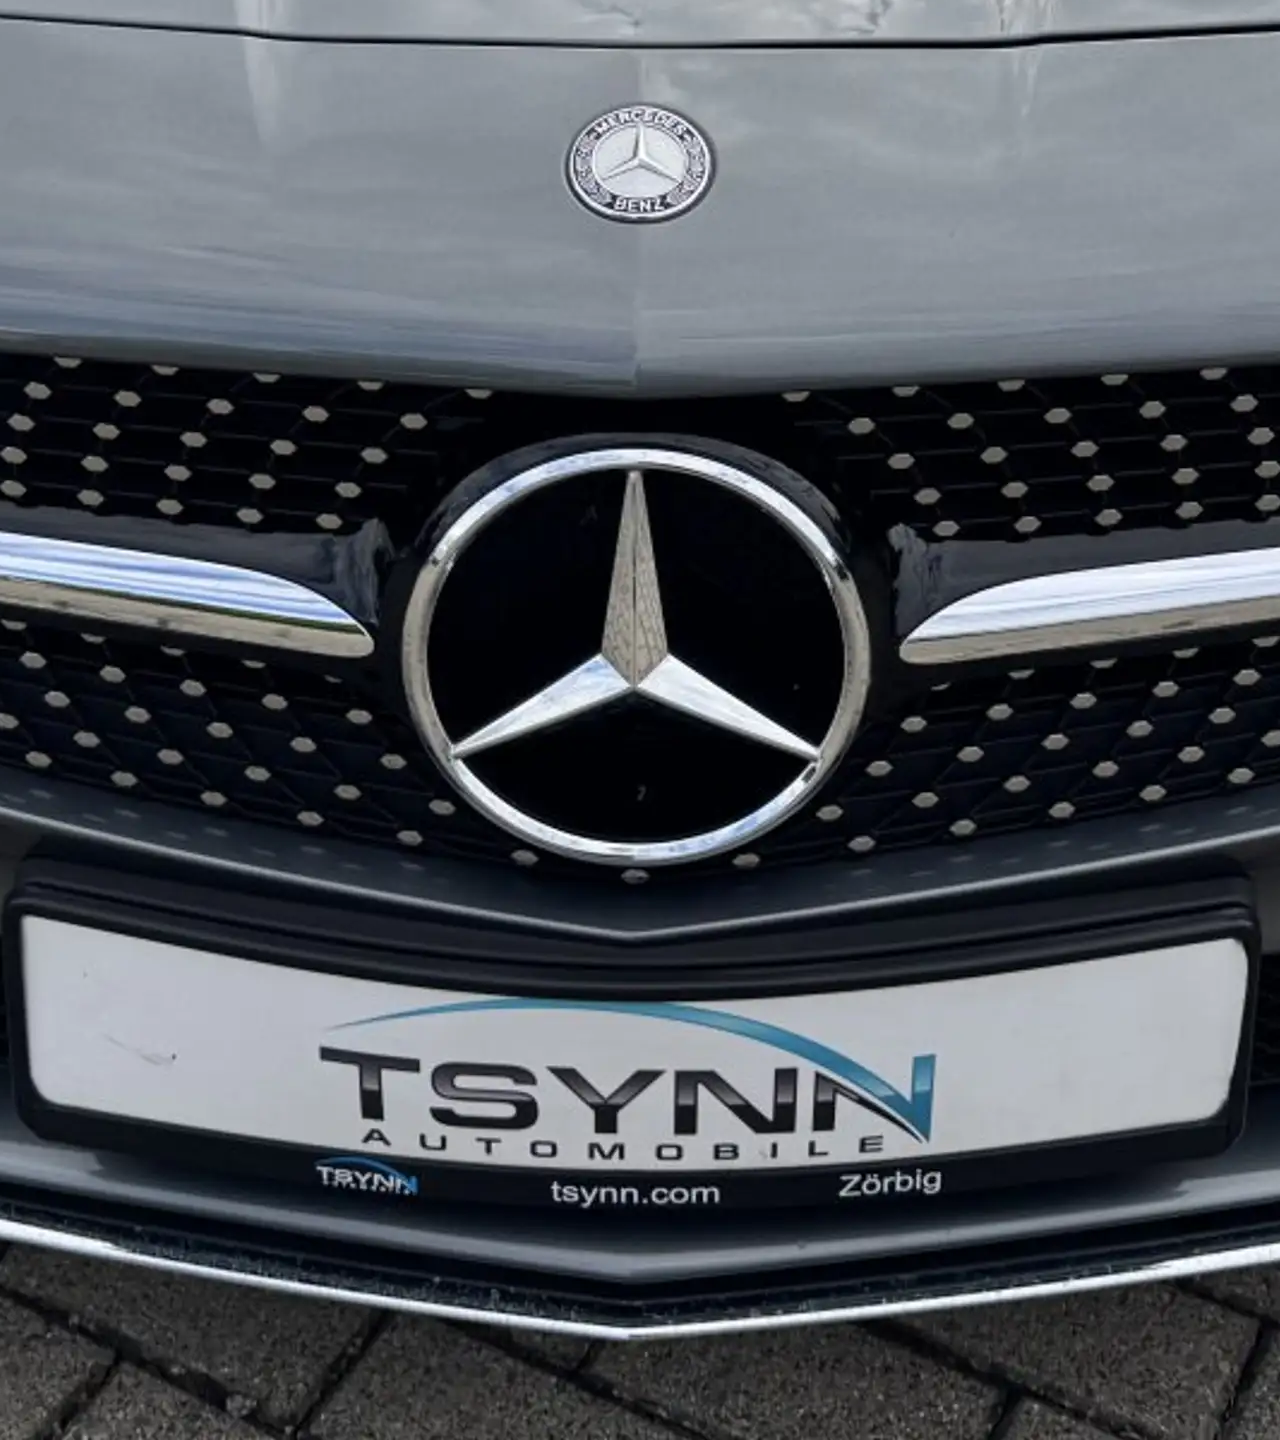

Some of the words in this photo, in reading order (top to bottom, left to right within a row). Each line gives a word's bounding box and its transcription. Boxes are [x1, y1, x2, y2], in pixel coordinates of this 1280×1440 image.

[594, 108, 687, 135] MERCEDES
[613, 197, 666, 213] BENZ
[319, 1046, 937, 1144] TSYNN
[360, 1127, 884, 1161] AUTOMOBILE
[550, 1180, 720, 1205] tsynn.com
[838, 1167, 943, 1198] Zörbig
